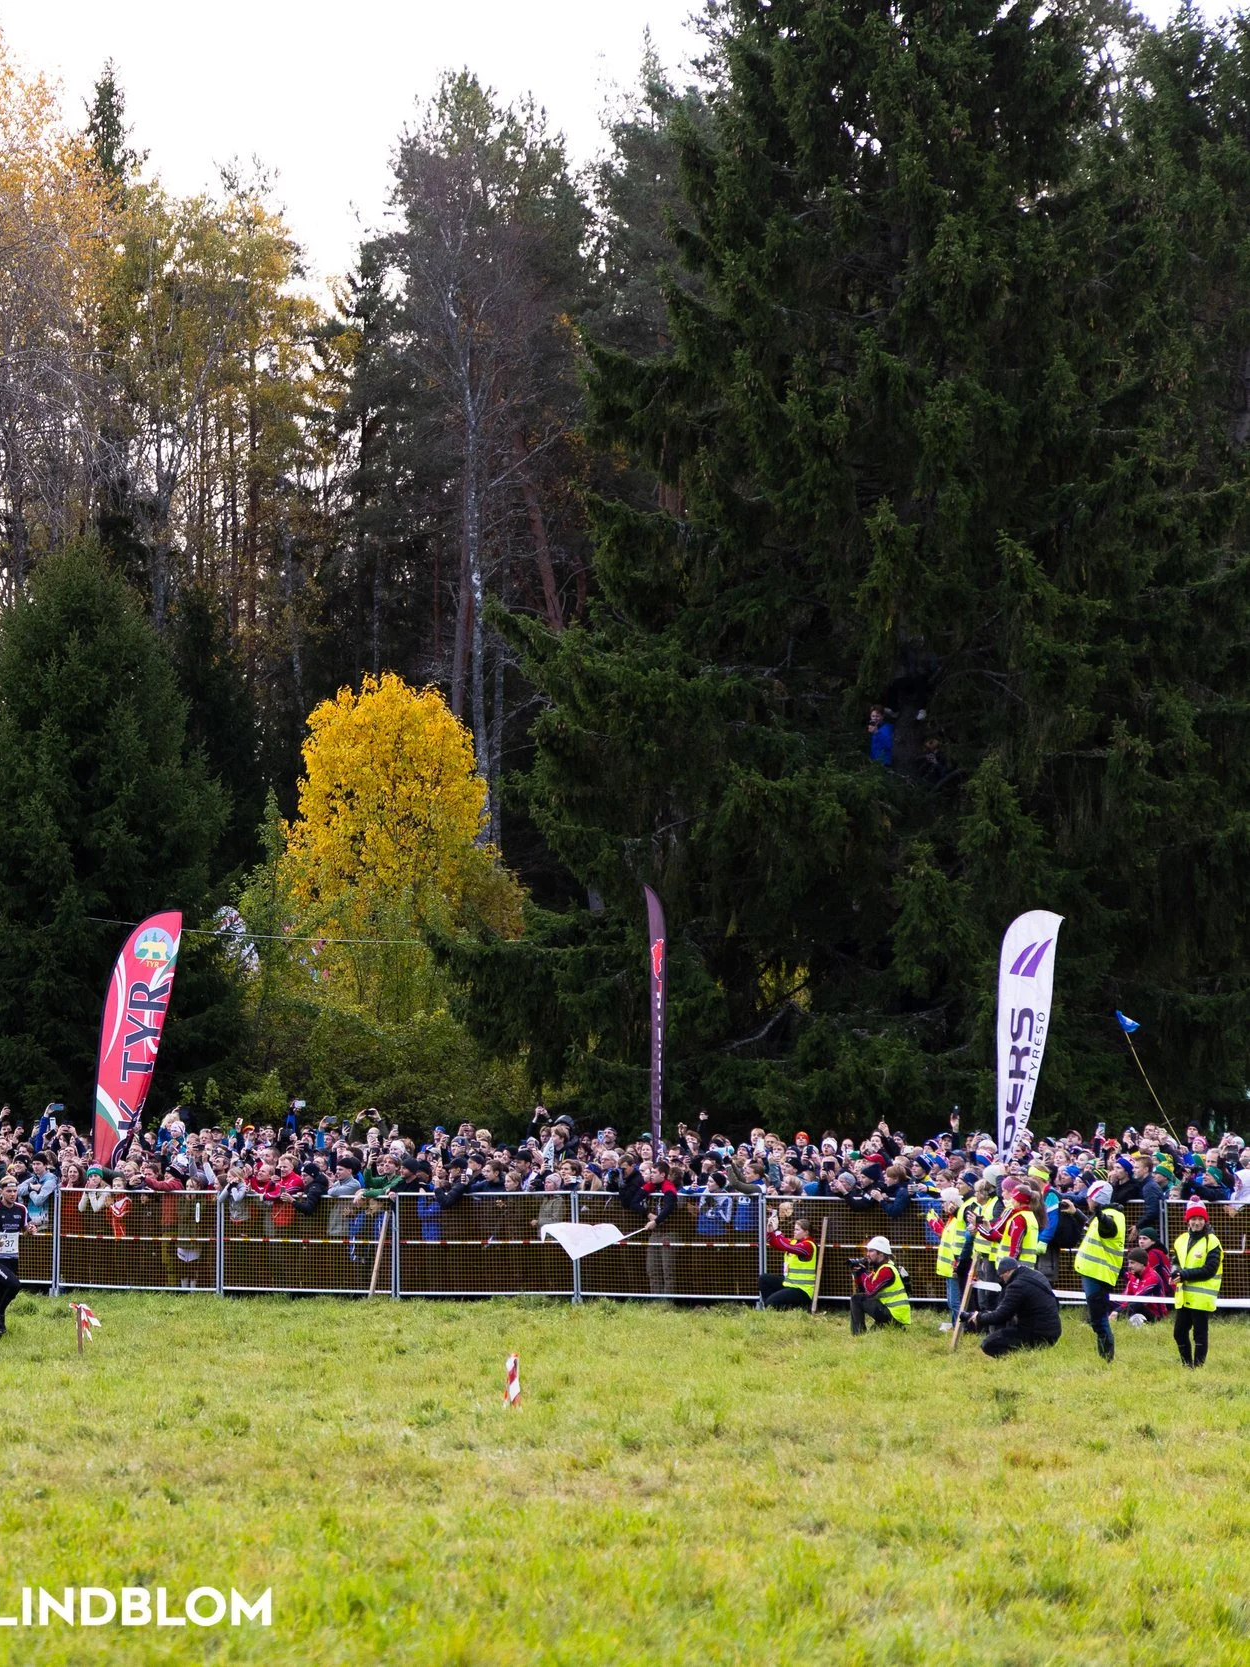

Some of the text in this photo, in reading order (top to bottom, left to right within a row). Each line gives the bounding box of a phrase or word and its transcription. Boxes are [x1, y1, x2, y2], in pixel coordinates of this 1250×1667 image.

[145, 960, 160, 968] TYR
[120, 980, 170, 1083] TYR
[1027, 1011, 1046, 1083] TYRESÖ
[1002, 1007, 1035, 1164] DERS
[4, 1239, 15, 1248] 37
